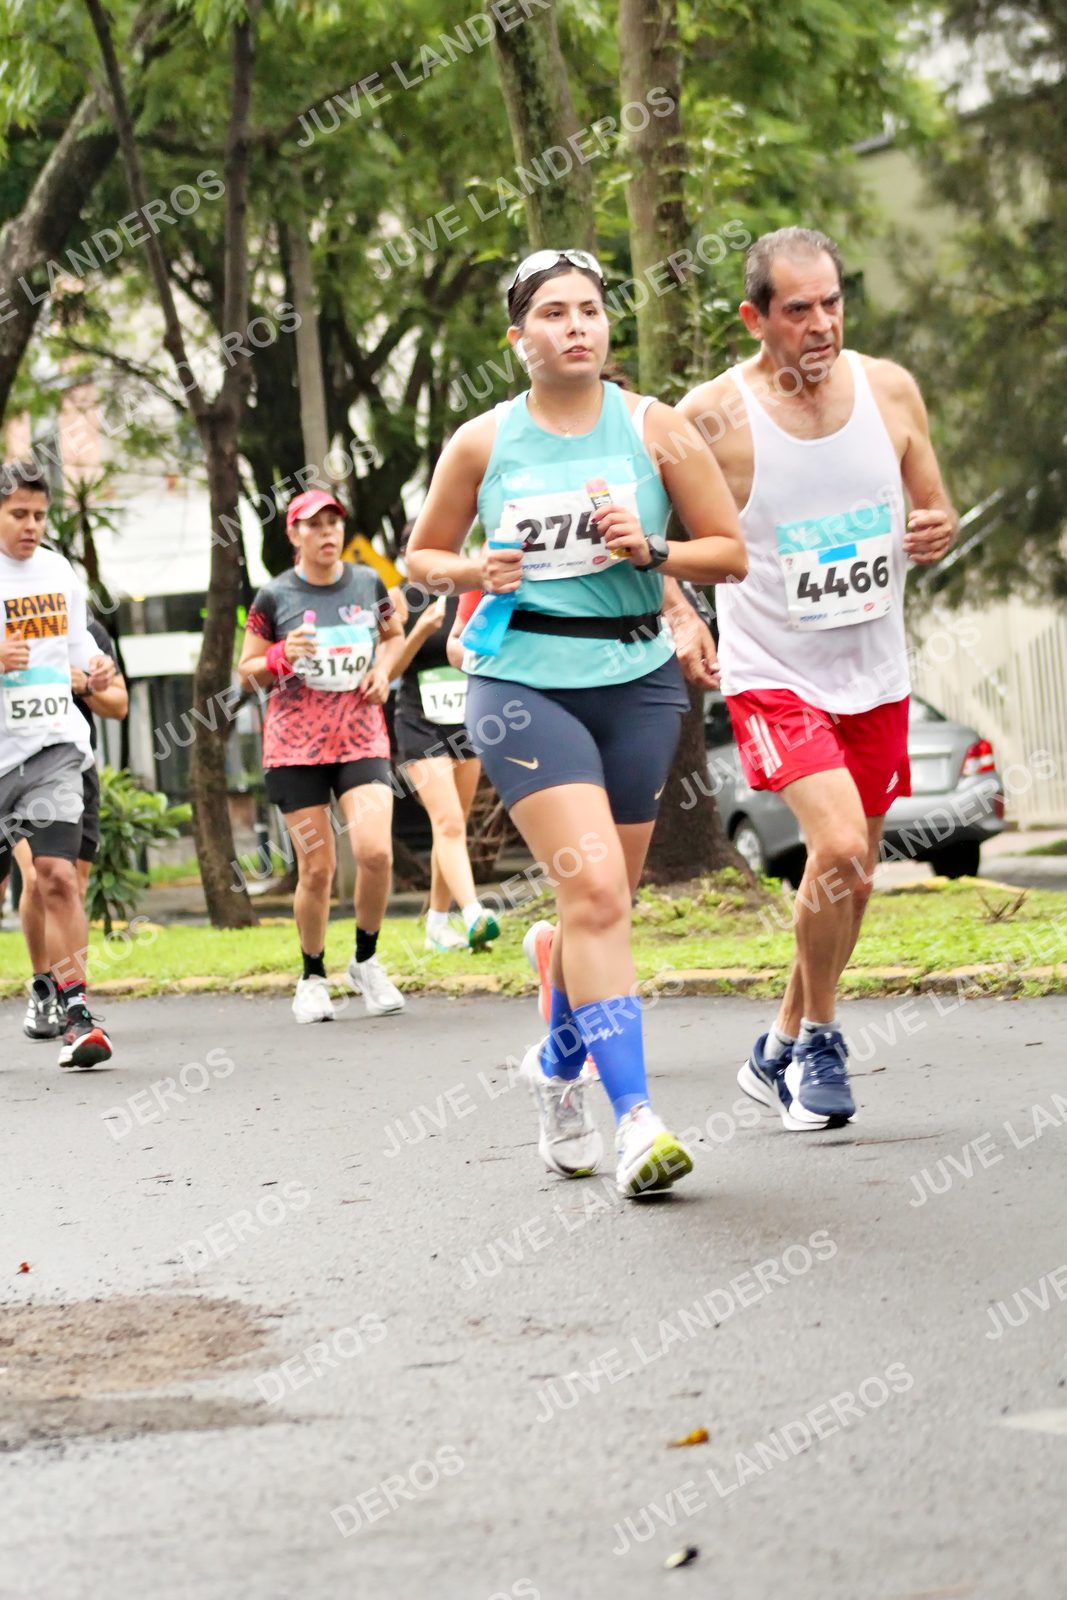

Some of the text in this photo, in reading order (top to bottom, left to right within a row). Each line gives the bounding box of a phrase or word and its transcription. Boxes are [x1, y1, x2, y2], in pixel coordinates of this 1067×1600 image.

[515, 511, 605, 553] 274
[797, 556, 889, 603] 4466
[4, 593, 68, 620] RAWA
[311, 655, 366, 677] 3140
[11, 697, 69, 721] 5207
[429, 692, 468, 709] 147
